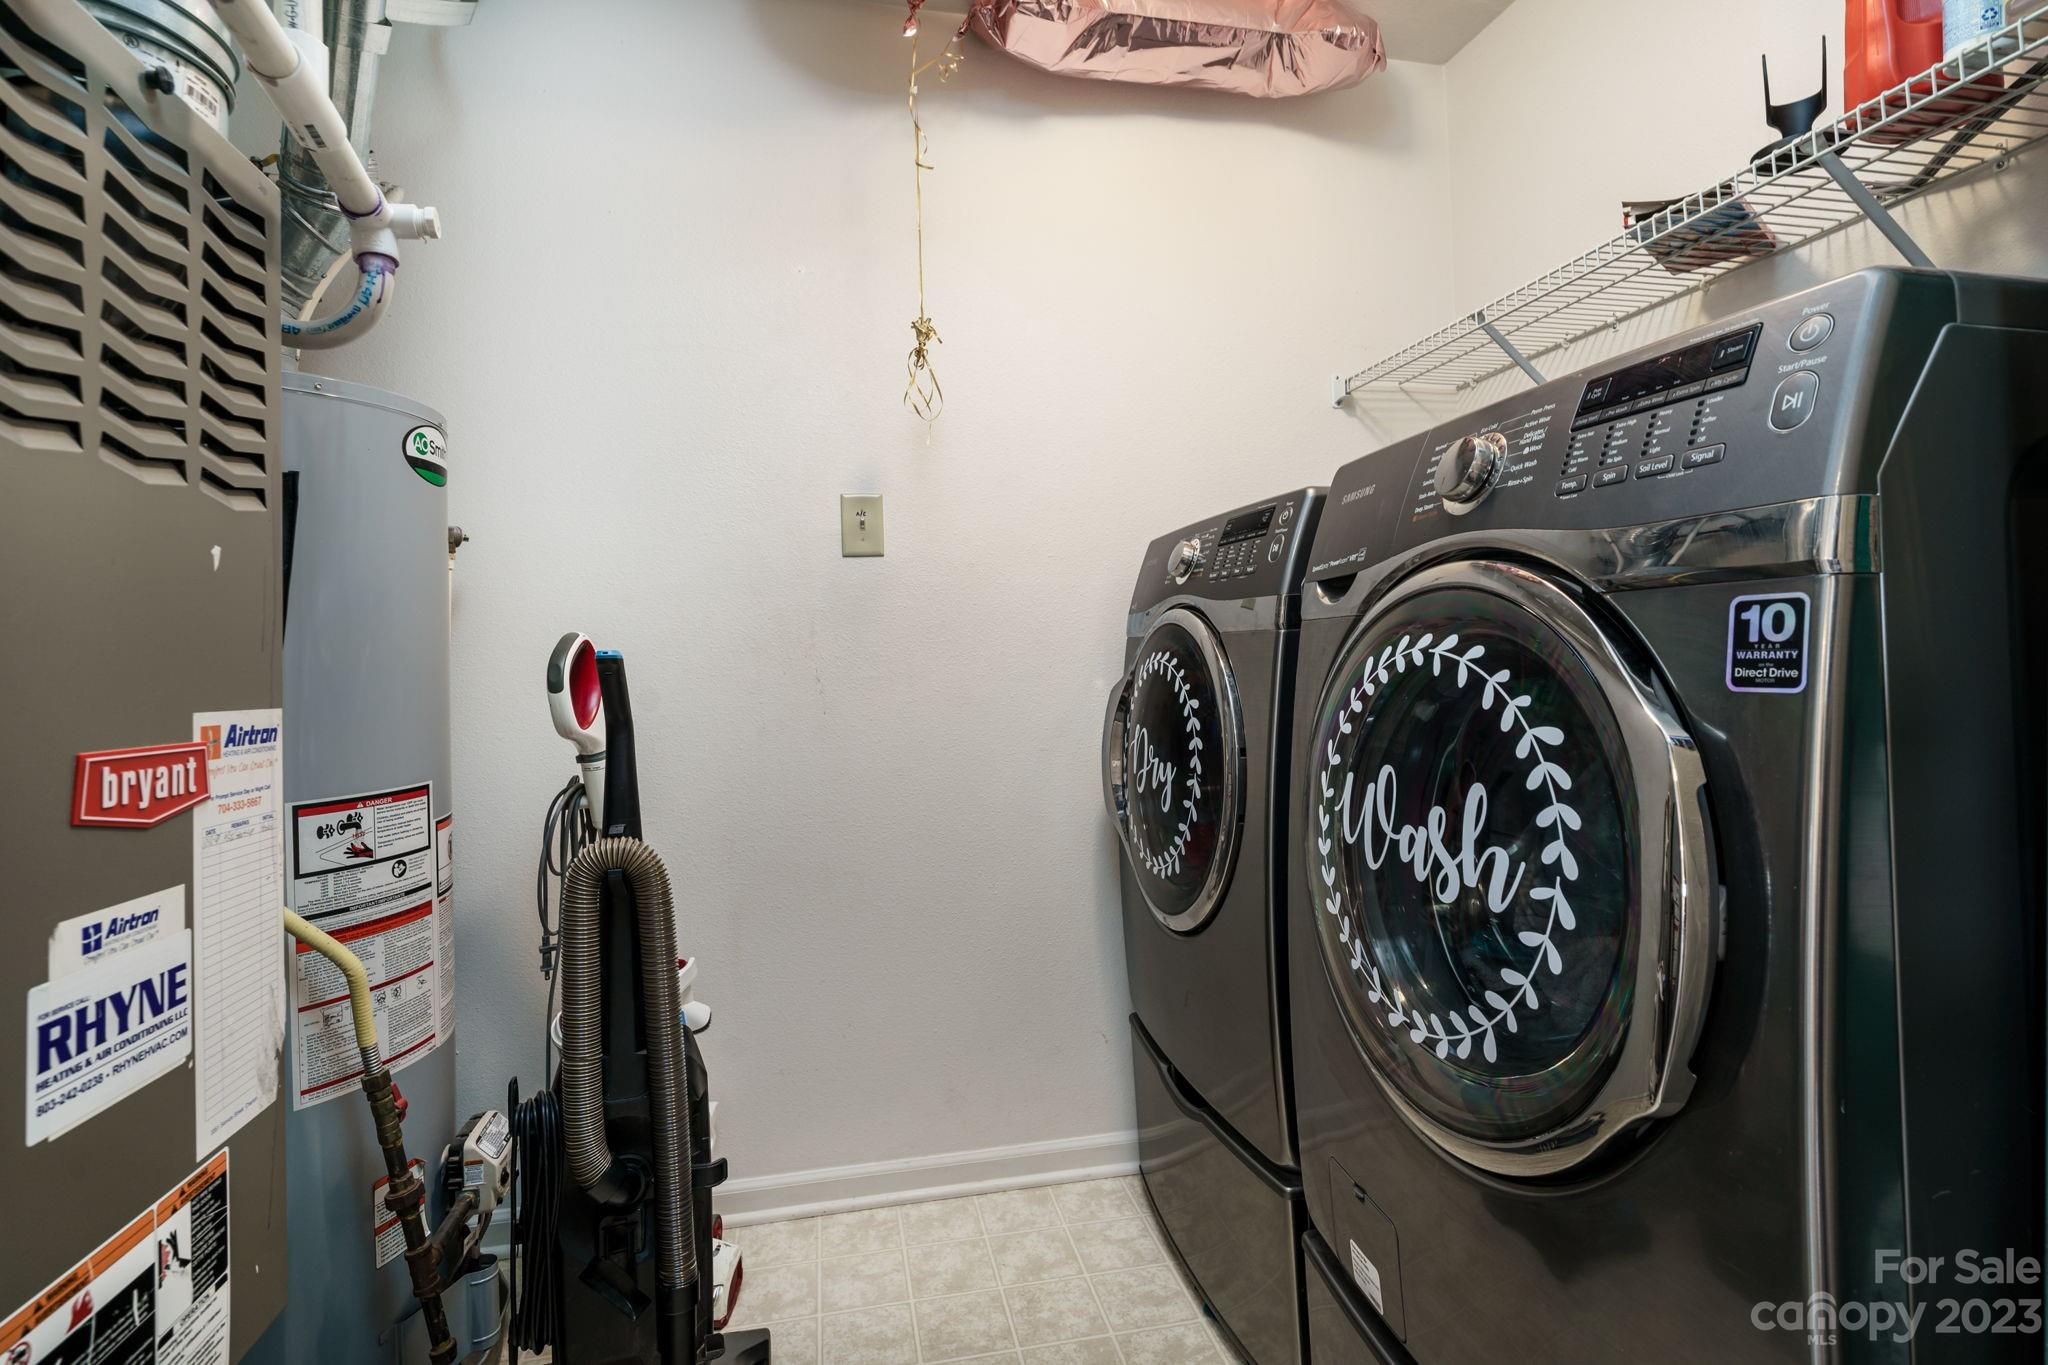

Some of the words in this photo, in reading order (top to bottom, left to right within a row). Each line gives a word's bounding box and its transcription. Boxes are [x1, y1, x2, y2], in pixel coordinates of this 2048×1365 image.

[1802, 302, 1830, 316] Power
[1777, 355, 1828, 374] Start/Pause
[1706, 394, 1724, 404] Louder
[1531, 406, 1543, 415] Perm
[1543, 403, 1556, 412] Press
[1659, 408, 1674, 418] Heavy
[1523, 419, 1538, 428] Active
[1538, 415, 1552, 424] Wear
[1654, 426, 1671, 436] Normal
[1519, 436, 1532, 446] Hand
[1532, 433, 1546, 443] Wash
[1529, 443, 1543, 452] Wool
[1690, 449, 1715, 464] Signal
[1510, 463, 1524, 473] Quick
[1524, 459, 1538, 469] Wash
[1639, 463, 1651, 473] Soil
[1651, 459, 1668, 471] Level
[1602, 471, 1616, 481] Spin
[1341, 484, 1376, 505] SAMSUNG
[855, 509, 867, 518] A/C
[1740, 602, 1797, 643] 10
[1736, 650, 1799, 659] WARRANTY
[1734, 667, 1767, 677] Direct
[1768, 667, 1799, 678] Drive
[223, 724, 278, 749] Airtron
[1129, 723, 1177, 814] Dry
[102, 757, 198, 809] bryant
[366, 797, 393, 807] DANGER
[205, 828, 216, 836] DATE
[1334, 764, 1526, 914] Wash
[105, 909, 159, 939] Airtron
[38, 1011, 50, 1020] FOR
[51, 1002, 75, 1015] SERVICE
[76, 997, 91, 1006] CALL
[37, 963, 187, 1076] RHYNE
[36, 1060, 83, 1093] HEATING
[84, 1056, 93, 1067] &
[95, 1046, 113, 1061] AIR
[113, 1016, 174, 1053] CONDITIONING
[174, 1007, 188, 1020] LLC
[112, 1027, 188, 1076] RHYNEHVAC.COM
